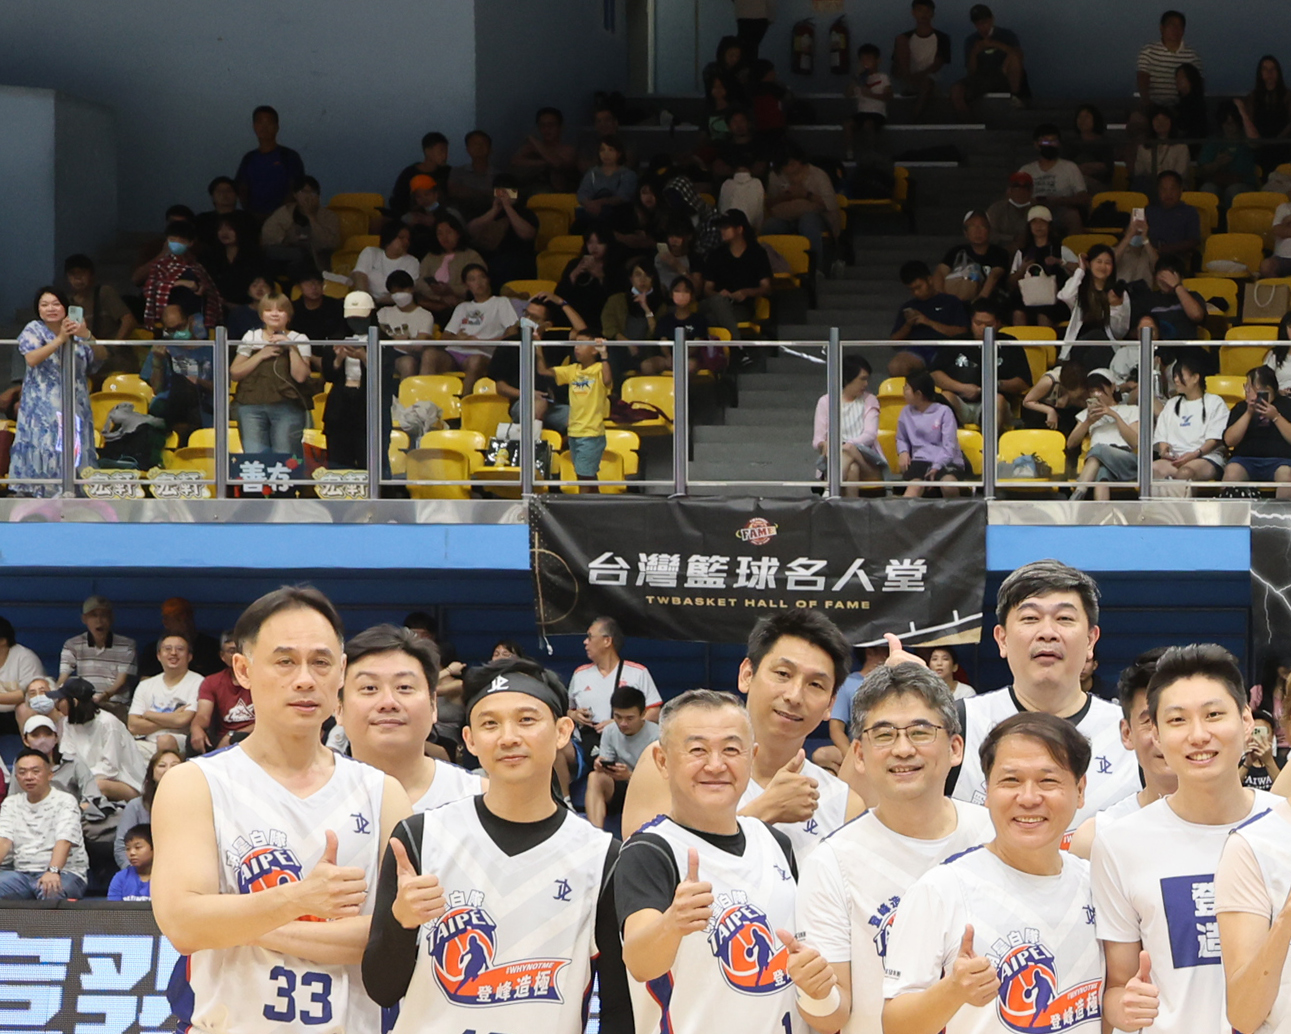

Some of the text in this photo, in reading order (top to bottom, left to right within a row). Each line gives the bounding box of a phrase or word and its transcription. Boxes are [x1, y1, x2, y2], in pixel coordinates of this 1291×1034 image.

[586, 550, 928, 594] 台灣籃球名人堂
[645, 595, 871, 610] TWBASKET HALL OF FAME
[1244, 774, 1273, 785] AIWA
[238, 849, 303, 885] AIPEI
[1191, 881, 1216, 918] 登
[427, 909, 498, 951] TAIPEI
[707, 903, 766, 956] TAIPEI
[1195, 921, 1222, 959] 造
[998, 943, 1055, 983] AIPEI
[262, 965, 333, 1026] 33
[475, 970, 552, 1003] 登峰造極
[1048, 989, 1100, 1032] 登峰造極
